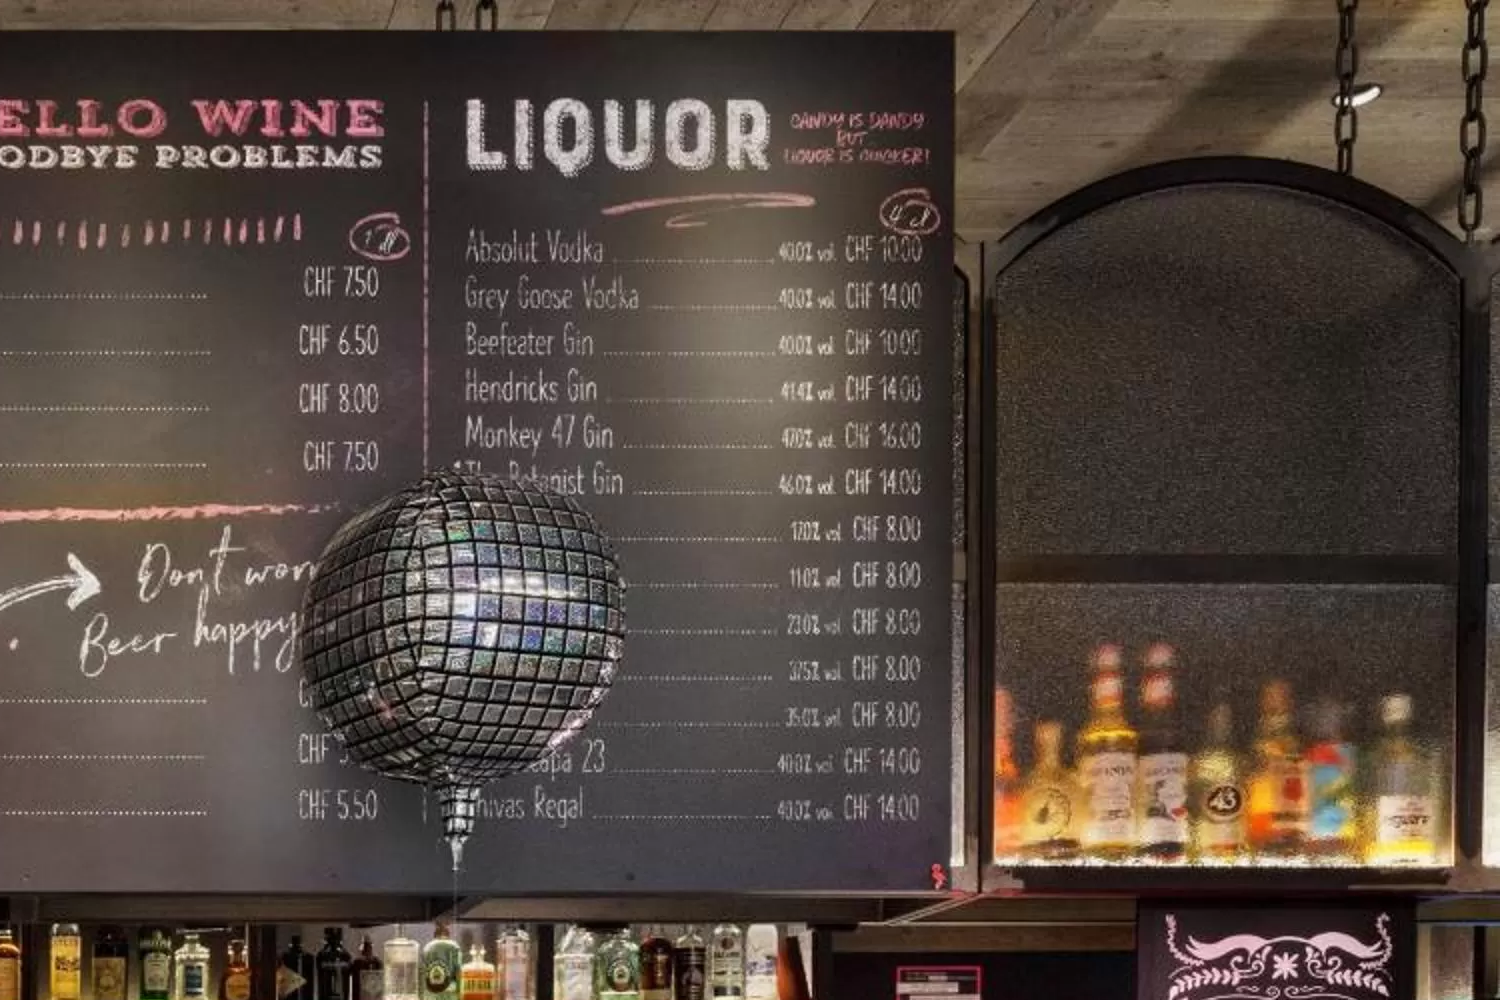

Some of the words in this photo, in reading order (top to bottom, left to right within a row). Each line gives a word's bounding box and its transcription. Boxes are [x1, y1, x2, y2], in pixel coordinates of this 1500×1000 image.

[191, 98, 385, 137] WINE
[465, 97, 771, 178] LIQUOR
[155, 144, 383, 169] PROBLEMS
[465, 228, 538, 264] Absolut
[546, 229, 604, 264] Vodka
[845, 234, 873, 263] CHF
[303, 265, 335, 297] CHF
[464, 274, 510, 317] Grey
[517, 274, 573, 310] Goose
[582, 275, 639, 310] Vodka
[845, 281, 874, 309] CHF
[299, 324, 331, 356] CHF
[338, 324, 379, 356] 6.50
[465, 320, 554, 356] Beefeater
[563, 321, 594, 357] Gin
[845, 328, 873, 356] CHF
[299, 382, 331, 414] CHF
[338, 383, 379, 414] 8.00
[465, 367, 558, 403] Hendricks
[567, 367, 598, 403] Gin
[845, 375, 874, 402] CHF
[465, 415, 542, 460] Monkey
[551, 414, 576, 447] 47
[582, 413, 614, 449] Gin
[845, 421, 870, 449] CHF
[303, 440, 335, 472] CHF
[592, 460, 624, 495] Gin
[845, 468, 873, 495] CHF
[879, 468, 922, 496] 14.00
[852, 515, 881, 542] CHF
[885, 515, 922, 542] 8.00
[852, 561, 880, 589] CHF
[885, 560, 922, 589] 8.00
[80, 613, 177, 676] Beer
[193, 584, 301, 675] happy
[852, 607, 879, 635] CHF
[885, 607, 921, 636] 8.00
[851, 654, 879, 681] CHF
[885, 655, 921, 681] 8.00
[851, 701, 879, 728] CHF
[885, 700, 921, 728] 8.00
[299, 733, 329, 764] CHF
[583, 739, 605, 773] 23
[843, 747, 872, 774] CHF
[299, 788, 331, 820] CHF
[337, 788, 377, 820] 5.50
[475, 784, 524, 818] hivas
[534, 784, 584, 828] Regal
[843, 793, 870, 821] CHF
